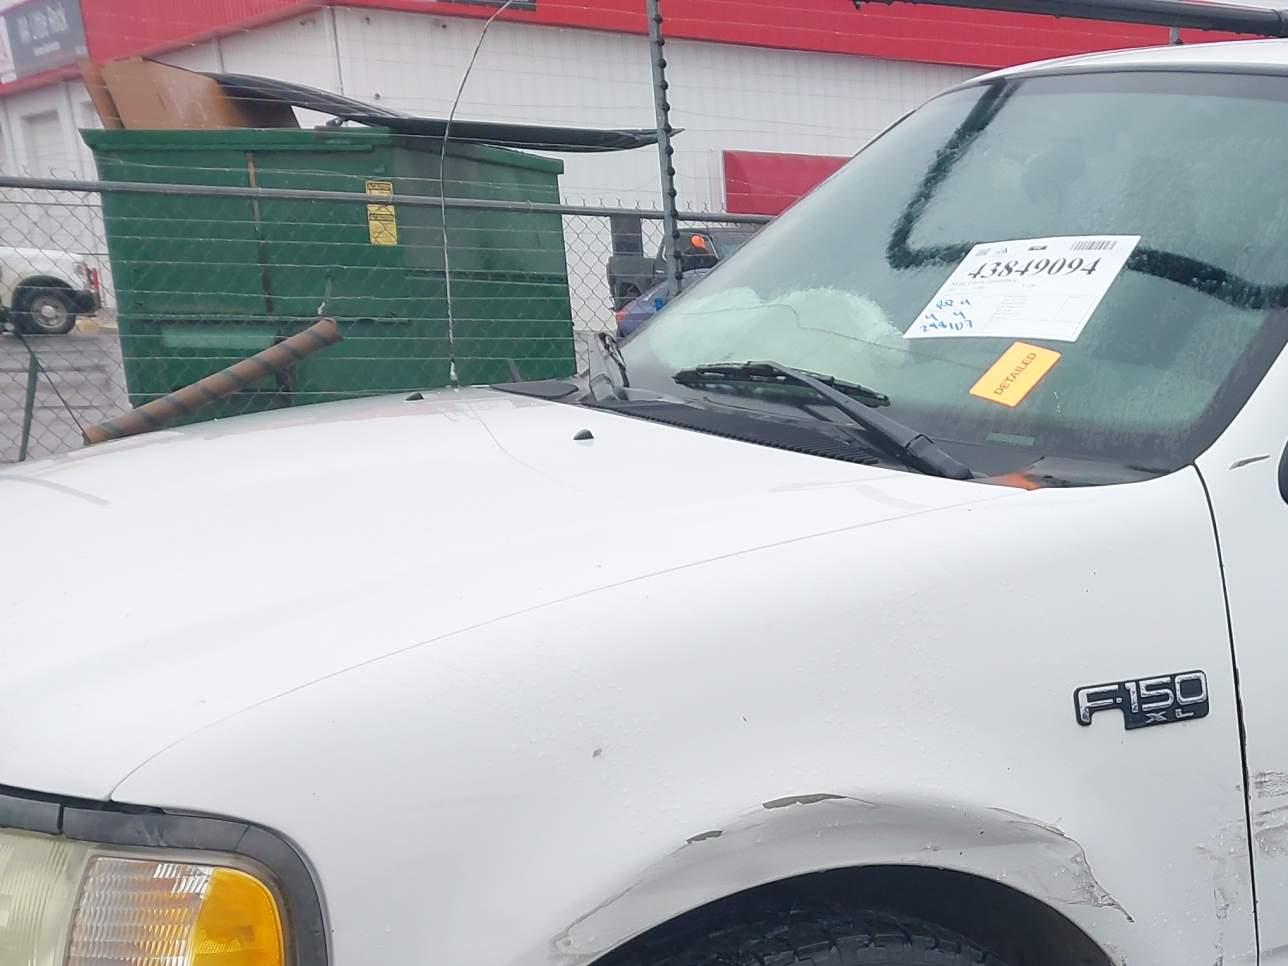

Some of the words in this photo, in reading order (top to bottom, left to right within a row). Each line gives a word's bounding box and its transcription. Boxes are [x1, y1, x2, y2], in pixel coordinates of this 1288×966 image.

[967, 256, 1102, 279] 43849094
[993, 352, 1037, 396] DETAILED
[1078, 672, 1208, 722] F-150
[1144, 708, 1195, 724] XL
